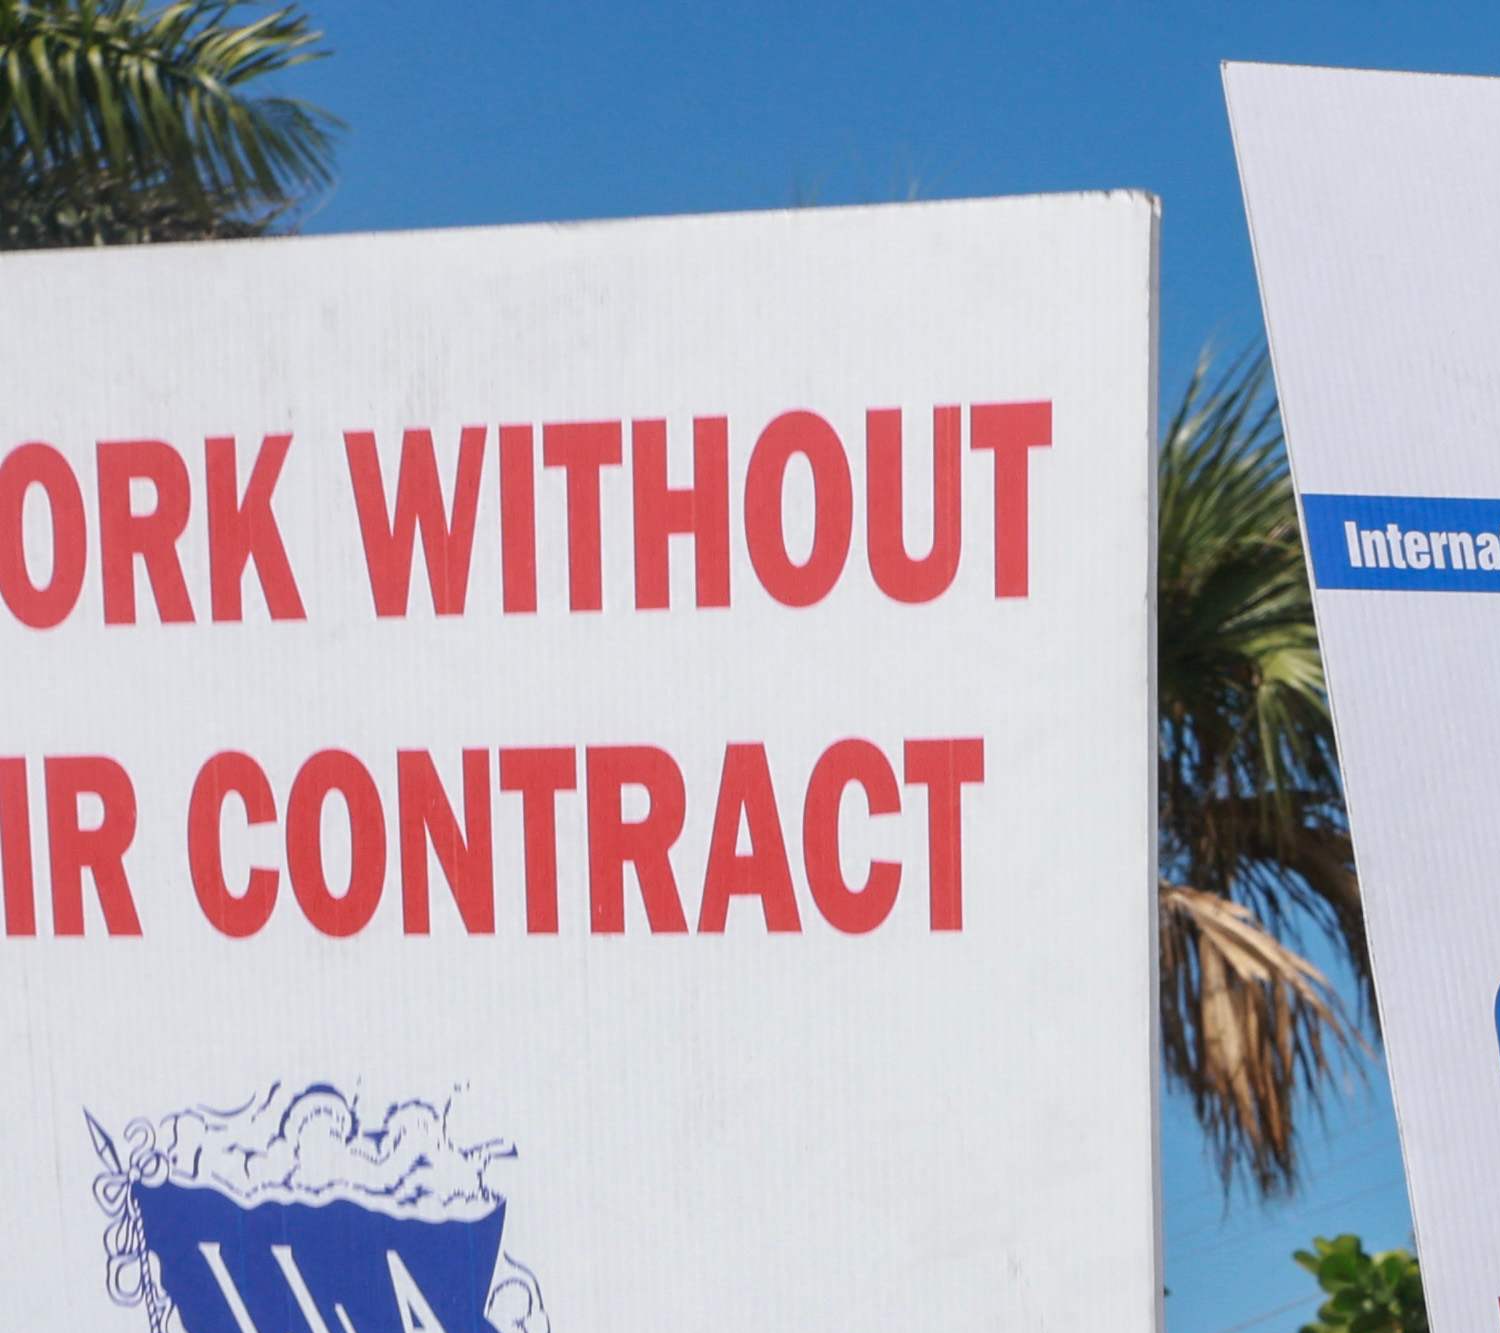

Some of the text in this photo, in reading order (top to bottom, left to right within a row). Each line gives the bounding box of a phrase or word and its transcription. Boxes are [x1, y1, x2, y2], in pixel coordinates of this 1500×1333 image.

[0, 400, 1053, 630] ORK WITHOUT
[0, 735, 985, 940] IR CONTRACT
